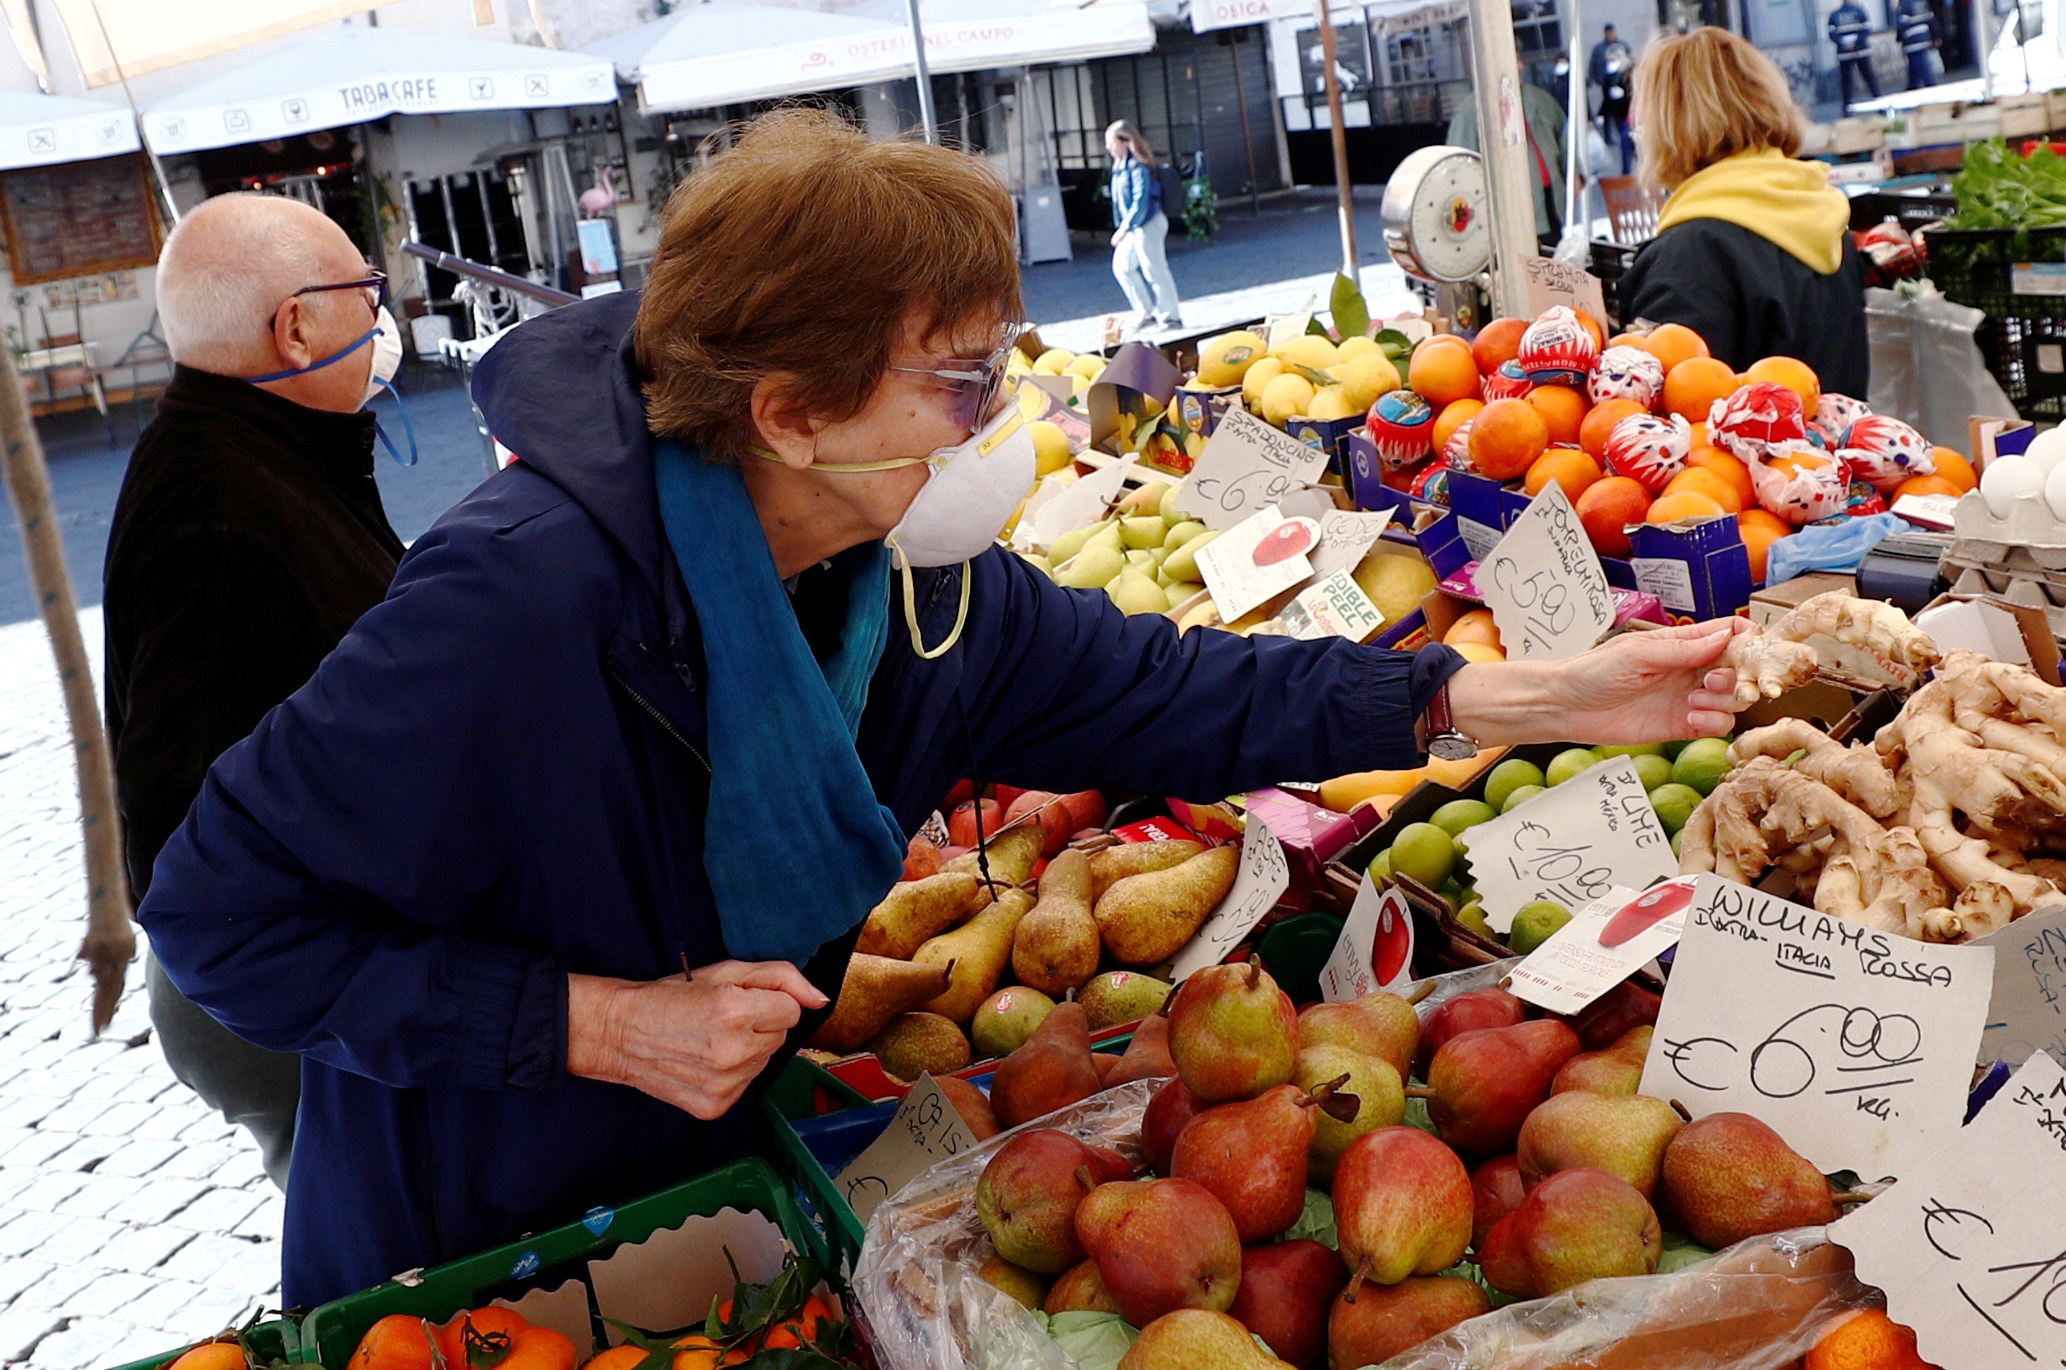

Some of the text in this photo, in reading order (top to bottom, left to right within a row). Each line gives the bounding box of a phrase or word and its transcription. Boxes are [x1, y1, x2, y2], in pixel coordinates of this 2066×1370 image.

[957, 26, 1013, 43] CAMPO
[1227, 411, 1318, 464] SPADONCINE
[1195, 477, 1221, 500] €
[1322, 584, 1358, 629] PEEL
[1331, 573, 1378, 627] EDIBLE
[1138, 823, 1169, 842] ERA!
[1513, 820, 1551, 851] €
[1620, 794, 1662, 849] LIME
[1860, 950, 1953, 987] ROSSA
[1664, 1036, 1738, 1091] €
[1921, 1197, 1995, 1260] €
